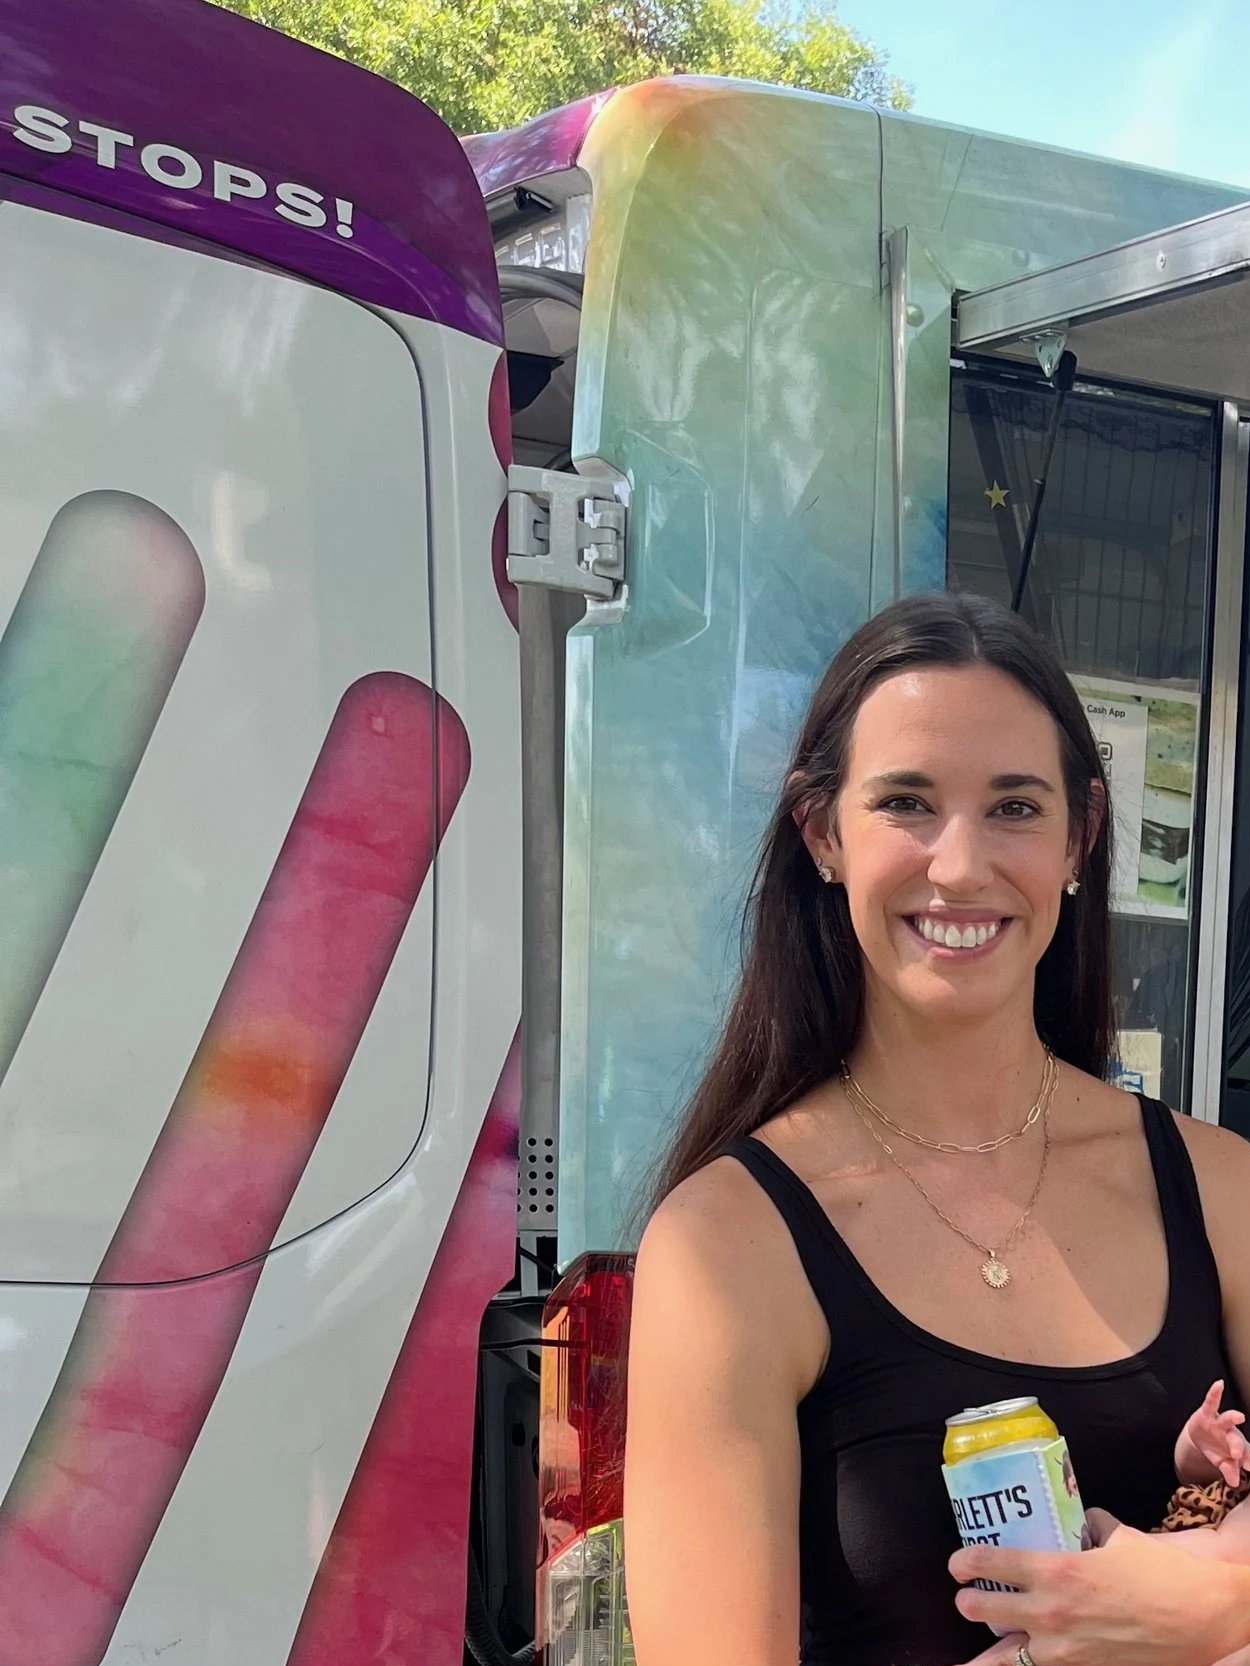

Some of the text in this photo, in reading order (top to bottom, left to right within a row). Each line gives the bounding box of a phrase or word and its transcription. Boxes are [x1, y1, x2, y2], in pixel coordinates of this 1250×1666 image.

[13, 105, 354, 239] STOPS!
[1086, 704, 1126, 718] Cash App
